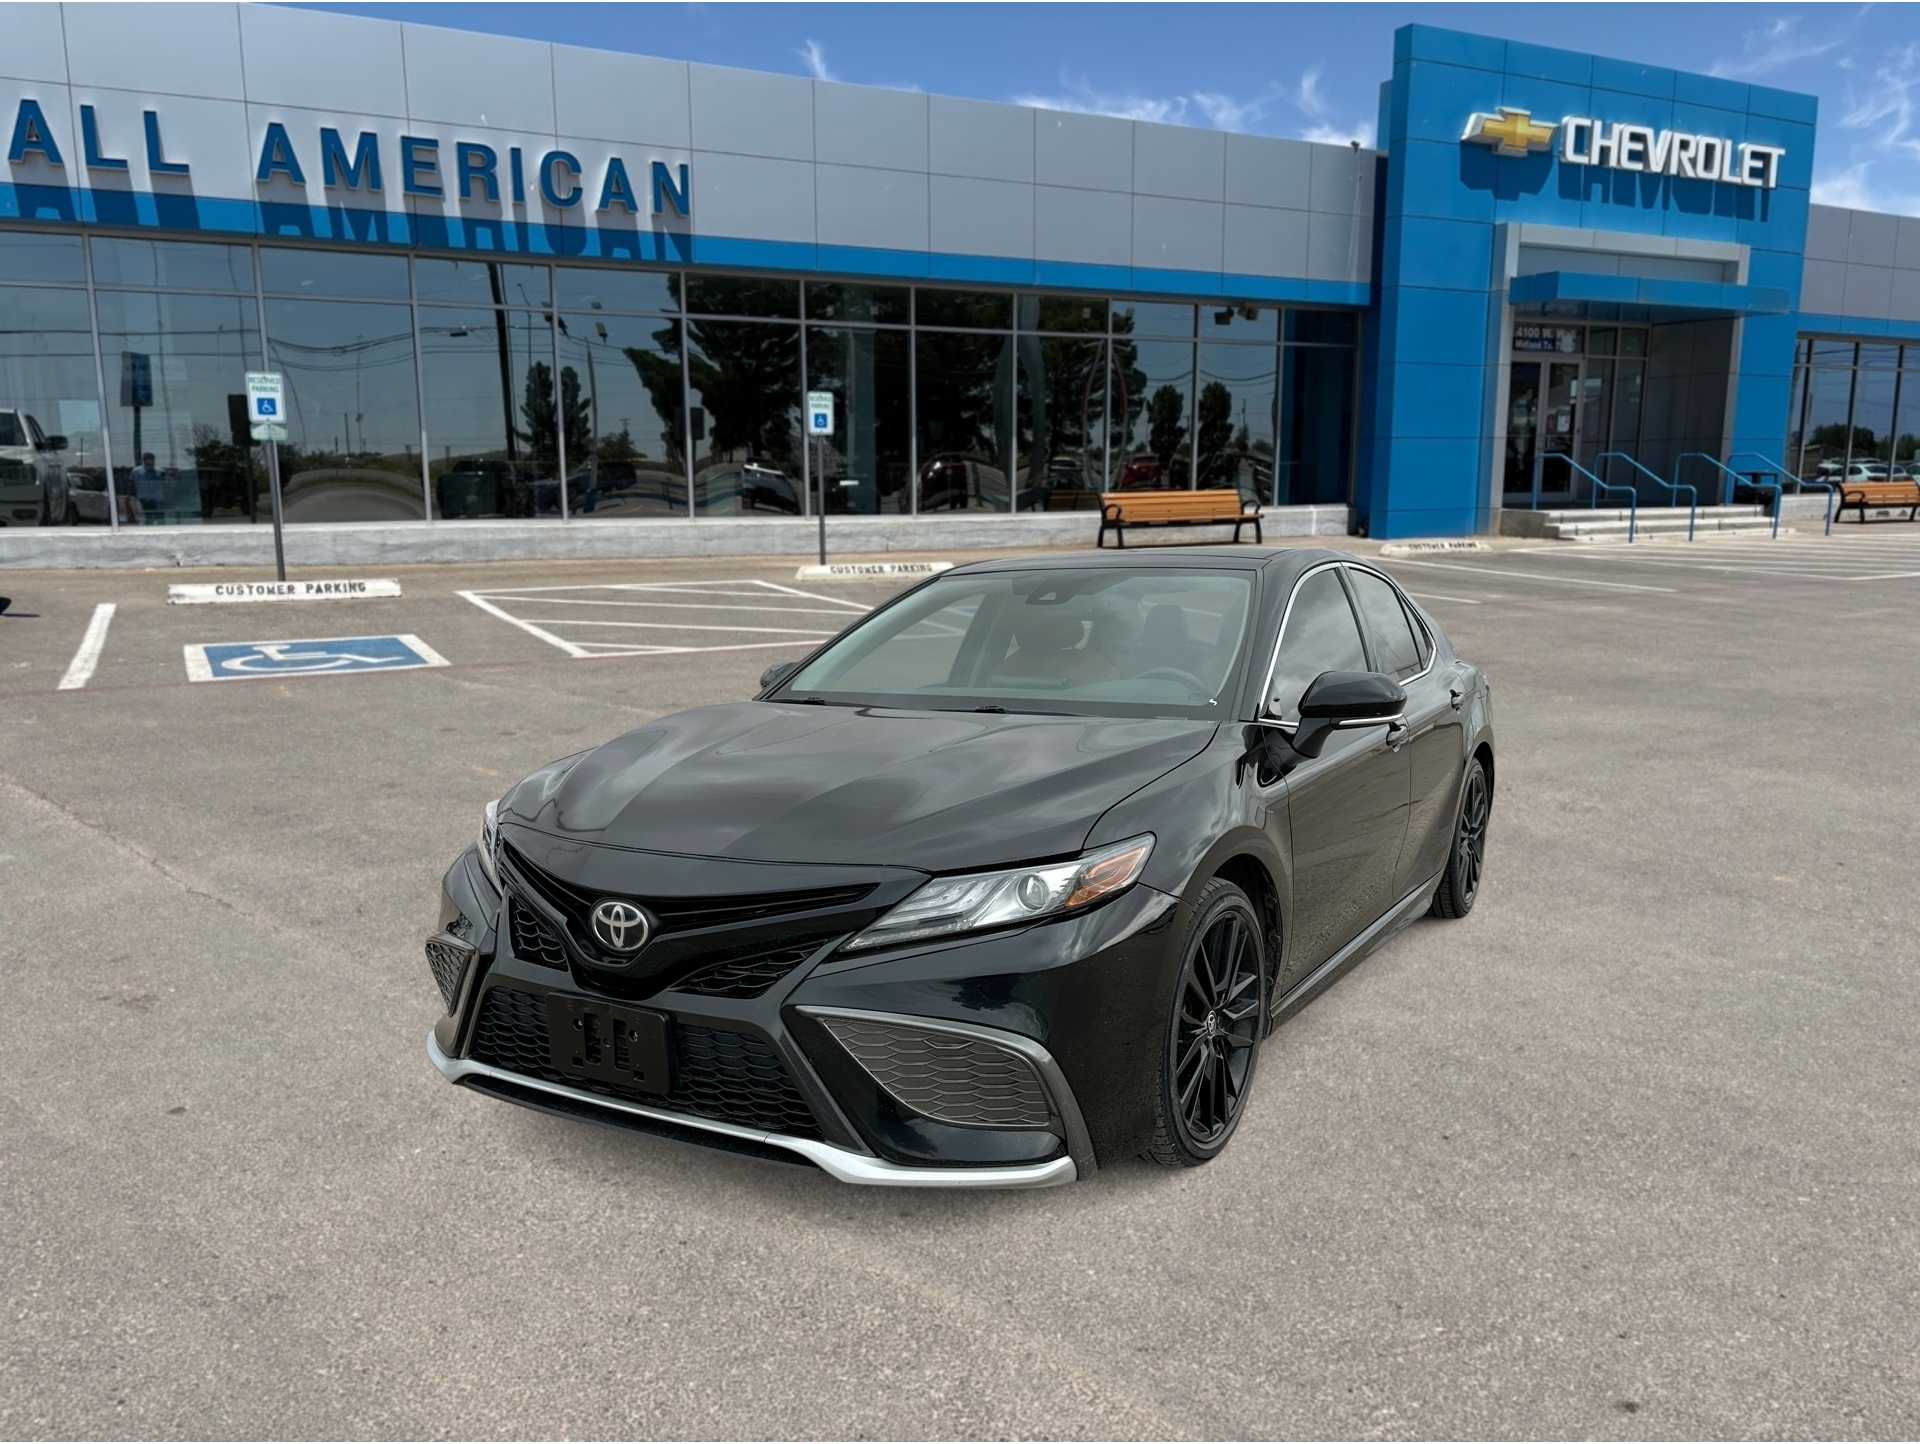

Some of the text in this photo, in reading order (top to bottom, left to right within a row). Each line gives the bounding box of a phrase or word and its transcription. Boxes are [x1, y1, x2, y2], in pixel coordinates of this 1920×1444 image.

[8, 98, 691, 217] ALL AMERICAN
[1560, 115, 1786, 189] CHEVROLET
[215, 582, 367, 596] CUSTOMER PARKING
[830, 563, 933, 575] CUSTOMER PARKING
